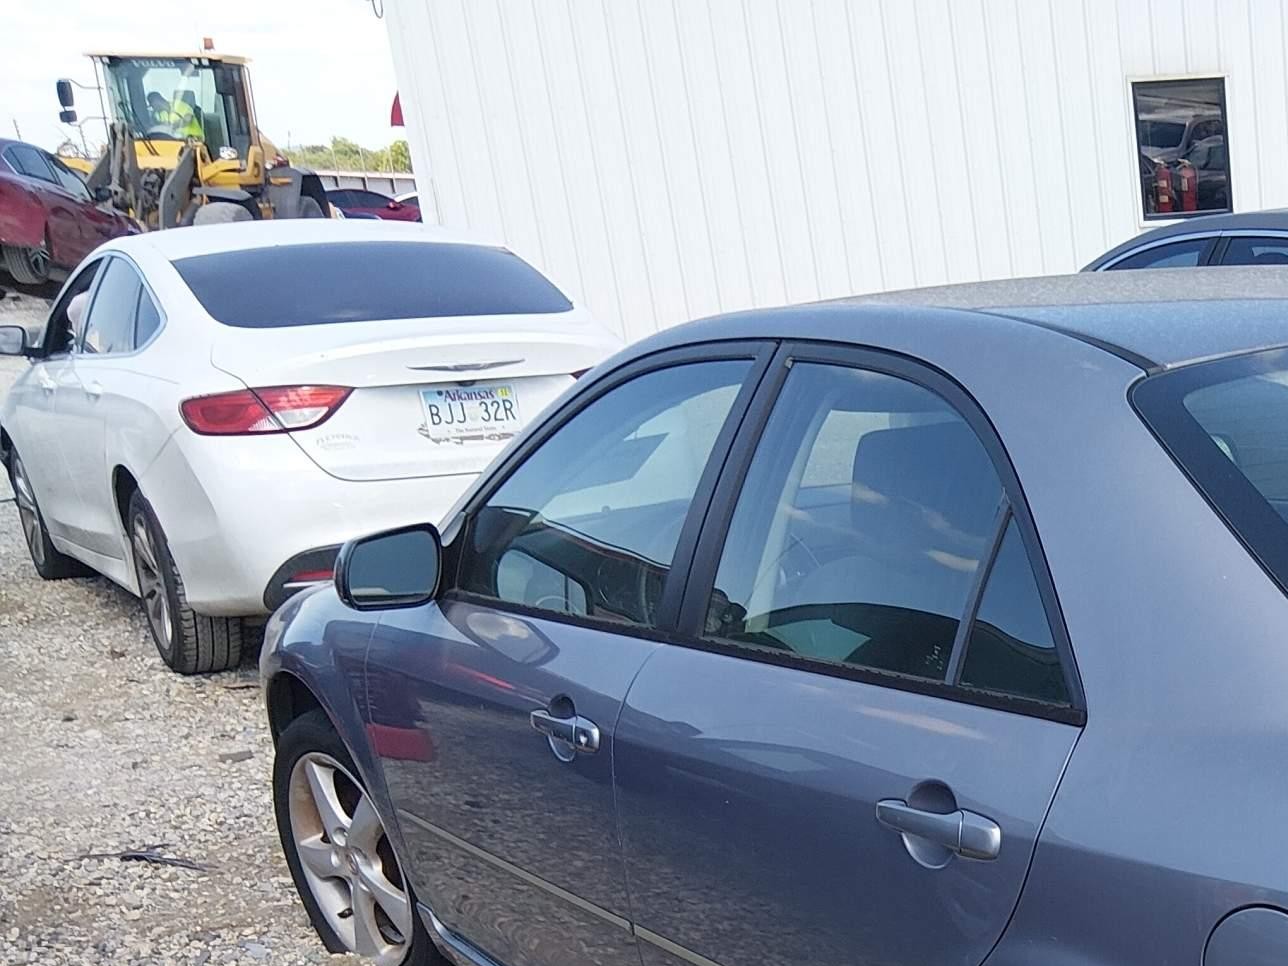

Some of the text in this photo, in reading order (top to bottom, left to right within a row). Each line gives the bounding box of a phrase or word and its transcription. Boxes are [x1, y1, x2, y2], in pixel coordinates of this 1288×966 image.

[443, 388, 496, 402] Arkansas
[428, 399, 517, 426] BJJ 32R
